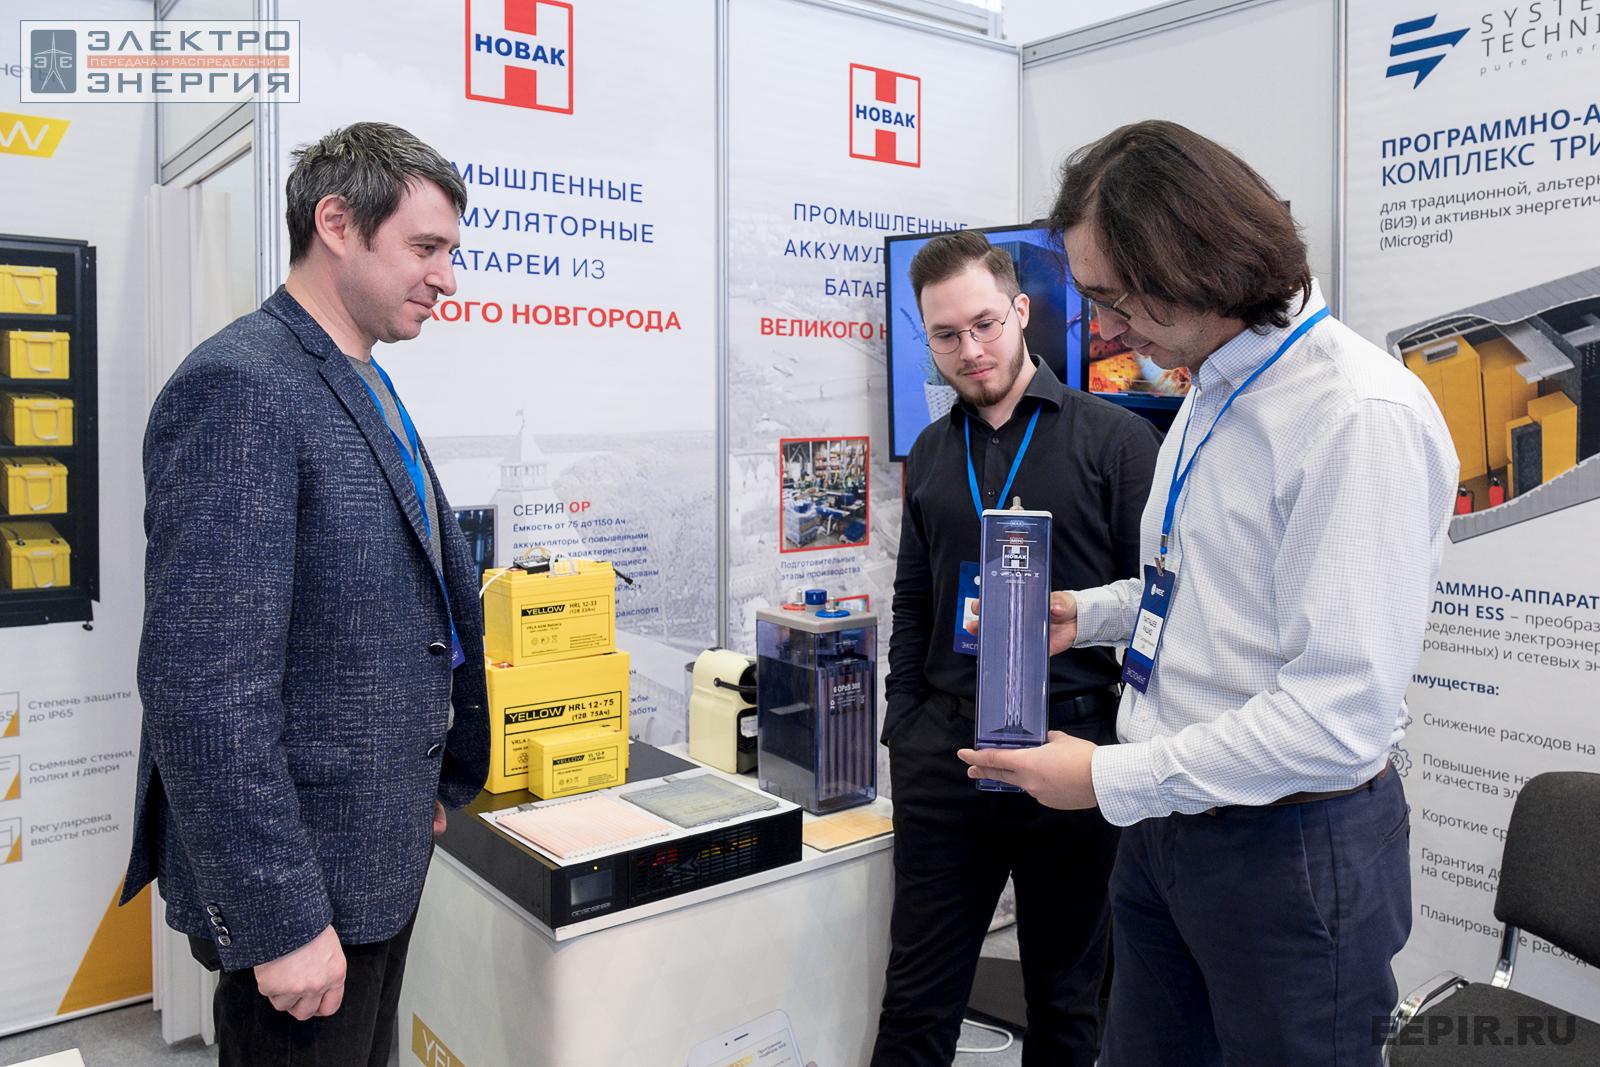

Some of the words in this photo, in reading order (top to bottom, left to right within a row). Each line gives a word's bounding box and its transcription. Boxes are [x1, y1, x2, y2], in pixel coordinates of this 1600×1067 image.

[475, 33, 565, 67] НОВАК
[1480, 58, 1528, 76] pure
[855, 104, 915, 129] НОВАК
[1382, 103, 1600, 158] ПРОГРАММНО-А
[1382, 143, 1535, 186] КОМПЛЕКС
[1380, 201, 1407, 215] для
[1411, 180, 1532, 210] традиционной,
[1537, 174, 1600, 193] альтер
[1380, 214, 1418, 233] (ВИЭ)
[1421, 215, 1431, 226] и
[1435, 205, 1511, 225] активных
[1380, 229, 1453, 251] (Microgrid)
[572, 257, 606, 280] ИЗ
[512, 303, 682, 333] НОВГОРОДА
[760, 317, 874, 339] ВЕЛИКОГО
[513, 503, 564, 517] СЕРИЯ
[526, 605, 563, 616] YELLOW
[1476, 605, 1505, 621] ESS
[1503, 650, 1512, 660] и
[1517, 651, 1580, 670] сетевых
[28, 698, 81, 710] Степень
[84, 690, 132, 704] защиты
[509, 707, 563, 723] YELLOW
[569, 703, 587, 711] HRL
[589, 698, 614, 709] 12-75
[28, 713, 45, 722] до
[48, 708, 74, 719] IP65
[1423, 713, 1496, 737] Снижение
[1501, 729, 1572, 751] расходов
[1576, 743, 1596, 755] на
[29, 771, 69, 784] полки
[72, 769, 79, 777] и
[83, 763, 120, 776] двери
[1423, 753, 1510, 783] Повышение
[1423, 771, 1431, 780] и
[1435, 773, 1499, 795] качества
[30, 813, 112, 835] Регулировка
[1422, 808, 1488, 834] Короткие
[31, 831, 78, 846] высоты
[82, 823, 120, 838] полок
[1421, 848, 1484, 875] Гарантия
[1421, 865, 1437, 877] на
